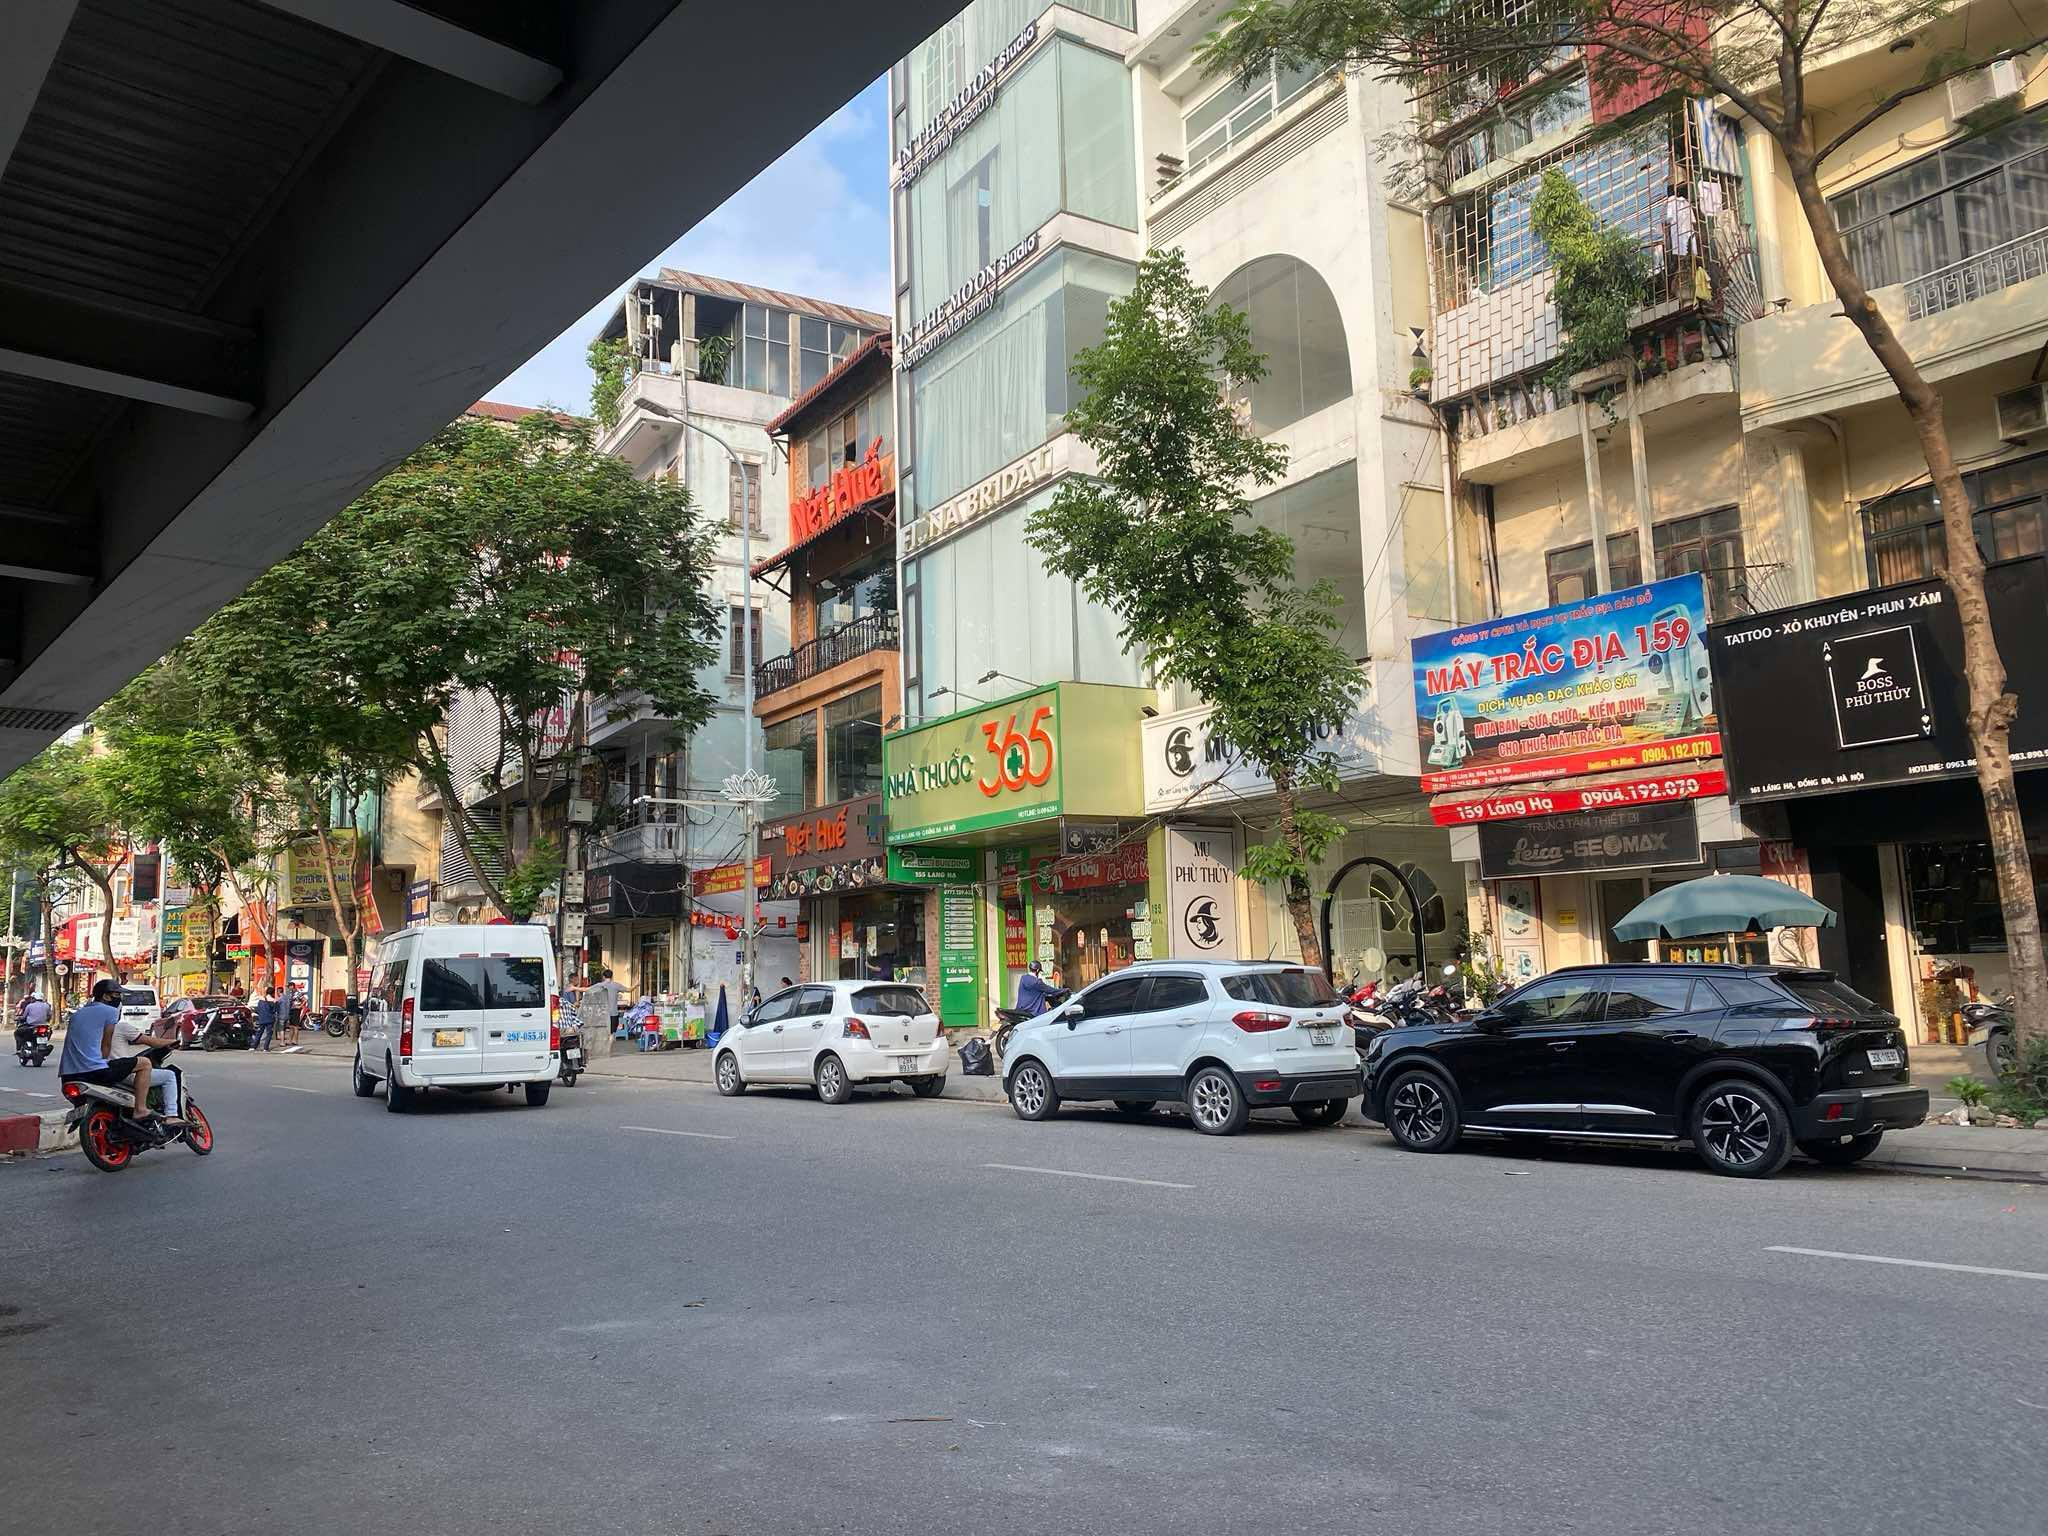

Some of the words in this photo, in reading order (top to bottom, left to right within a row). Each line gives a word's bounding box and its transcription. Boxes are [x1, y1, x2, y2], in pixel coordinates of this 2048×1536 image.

[916, 109, 946, 148] THE
[945, 61, 997, 116] MOON
[999, 22, 1034, 69] Studio
[901, 159, 922, 188] Baby
[926, 127, 954, 164] Family
[959, 88, 996, 132] Beauty
[917, 303, 947, 335] THE
[948, 260, 998, 311] MOON
[999, 235, 1036, 273] Studio
[832, 434, 884, 516] Huế
[964, 446, 1054, 521] BRIDAL
[1479, 630, 1490, 641] TY
[1725, 627, 1772, 647] TATTOO
[1782, 618, 1802, 635] XỎ
[1804, 606, 1859, 631] KHUYÊN
[1867, 599, 1905, 618] PHUN
[1908, 591, 1942, 609] XĂM
[1426, 657, 1485, 697] MÁY
[1489, 634, 1566, 685] TRẮC
[1572, 631, 1628, 674] ĐỊA
[1634, 616, 1692, 657] 159
[1823, 641, 1831, 652] A
[1478, 698, 1506, 714] DỊCH
[1508, 694, 1524, 711] VỤ
[1525, 691, 1544, 705] ĐO
[1548, 687, 1574, 703] ĐẠC
[1576, 677, 1613, 698] KHẢO
[1615, 672, 1639, 690] SÁT
[1845, 692, 1873, 709] PHÙ
[1873, 686, 1912, 704] THỦY
[1856, 676, 1894, 693] BOSS
[1474, 721, 1498, 739] MUA
[1498, 716, 1521, 736] BÁN
[1588, 697, 1617, 719] KIỂM
[1617, 696, 1647, 718] ĐỊNH
[889, 761, 919, 801] NHÀ
[919, 747, 975, 792] THUỐC
[978, 706, 1056, 798] 365
[1204, 731, 1234, 765] MỤ
[1498, 742, 1520, 757] CHO
[1521, 734, 1550, 754] THUÊ
[1550, 730, 1572, 750] MÁY
[1574, 724, 1602, 746] TRẮC
[1603, 723, 1624, 744] ĐỊA
[1642, 741, 1713, 763] 0904.192.070
[1763, 783, 1782, 793] LÁNG
[1797, 777, 1819, 789] ĐỐNG
[1837, 773, 1848, 783] HÀ
[1850, 771, 1865, 782] NỘI
[1909, 763, 1944, 774] HOTLINE:
[1457, 805, 1484, 820] 159
[1487, 799, 1525, 817] Láng
[1529, 797, 1554, 813] Hạ
[1580, 777, 1700, 806] 0904.192.070
[815, 804, 849, 852] Huế
[1194, 841, 1211, 862] MỤ
[1507, 837, 1565, 867] Leica
[1573, 831, 1667, 857] GEOMAX
[1175, 862, 1200, 884] PHÙ
[1201, 861, 1230, 884] THỦY
